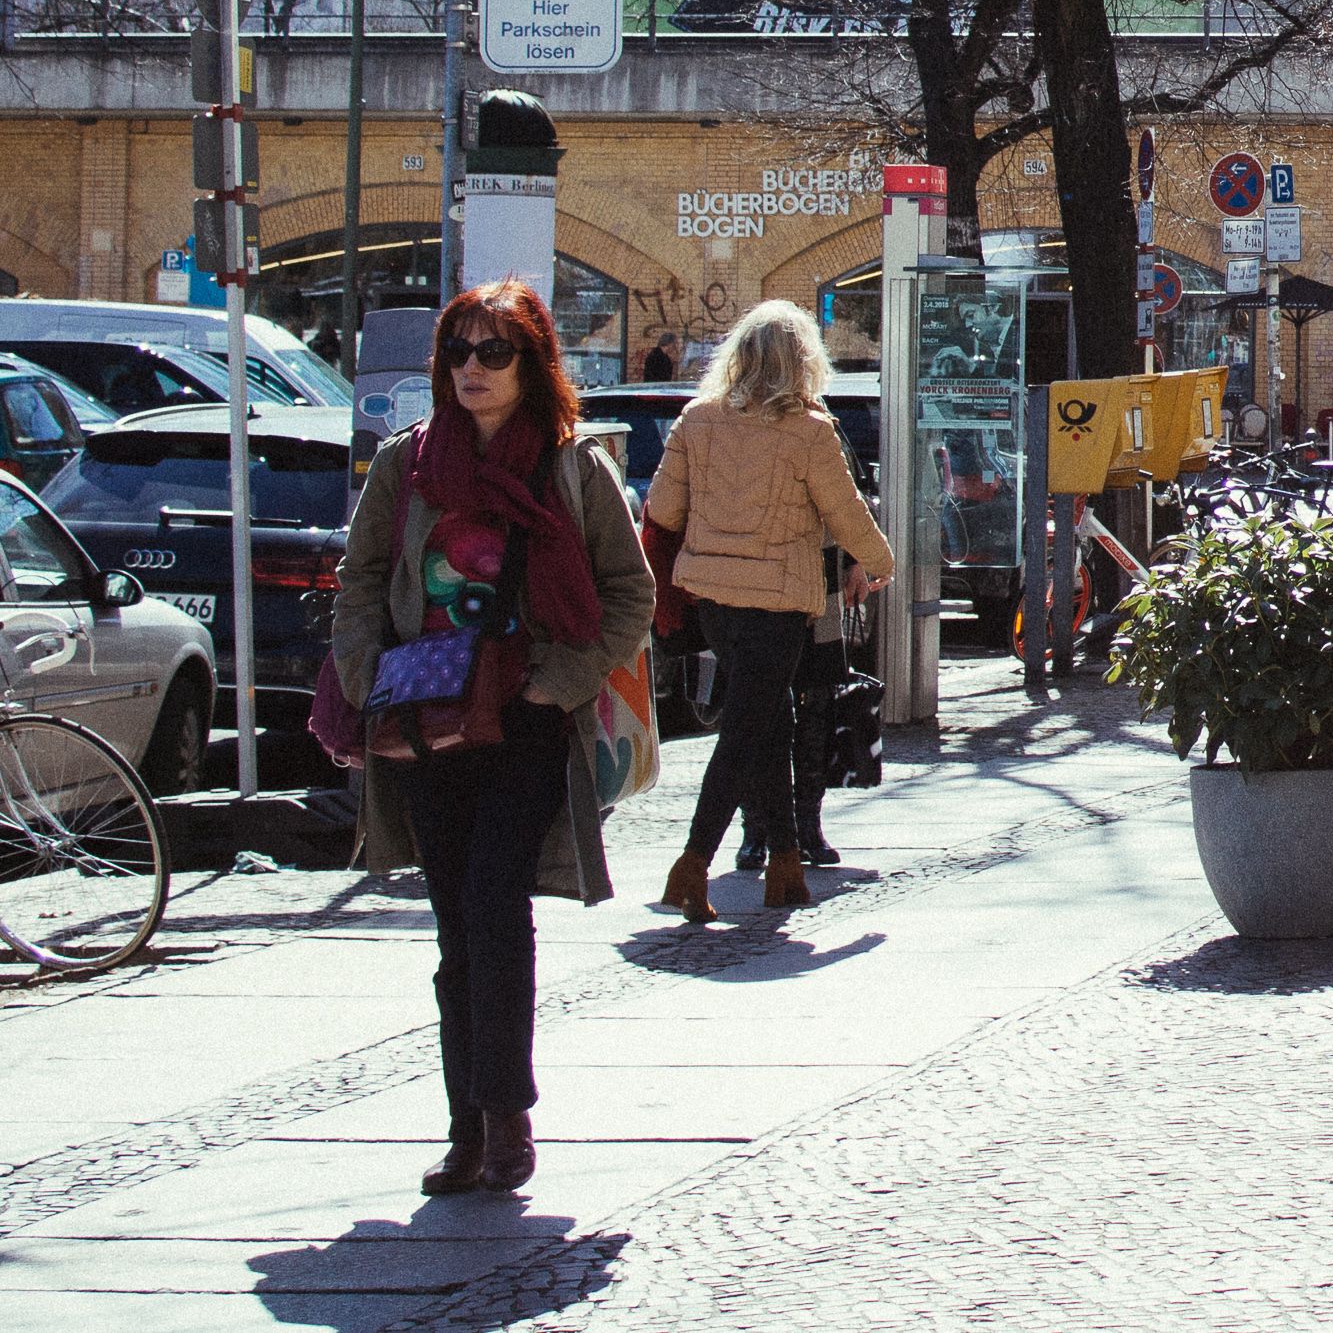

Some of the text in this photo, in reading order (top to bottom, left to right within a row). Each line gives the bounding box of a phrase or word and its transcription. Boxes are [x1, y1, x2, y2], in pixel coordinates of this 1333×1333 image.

[533, 0, 569, 15] Hier
[501, 22, 600, 37] Parkschein
[526, 44, 575, 59] lösen
[404, 156, 422, 168] 593
[1025, 161, 1046, 173] 594
[678, 189, 849, 216] BÜCHERBOGEN
[678, 216, 764, 238] BOGEN
[952, 386, 1011, 395] KRONENBERG
